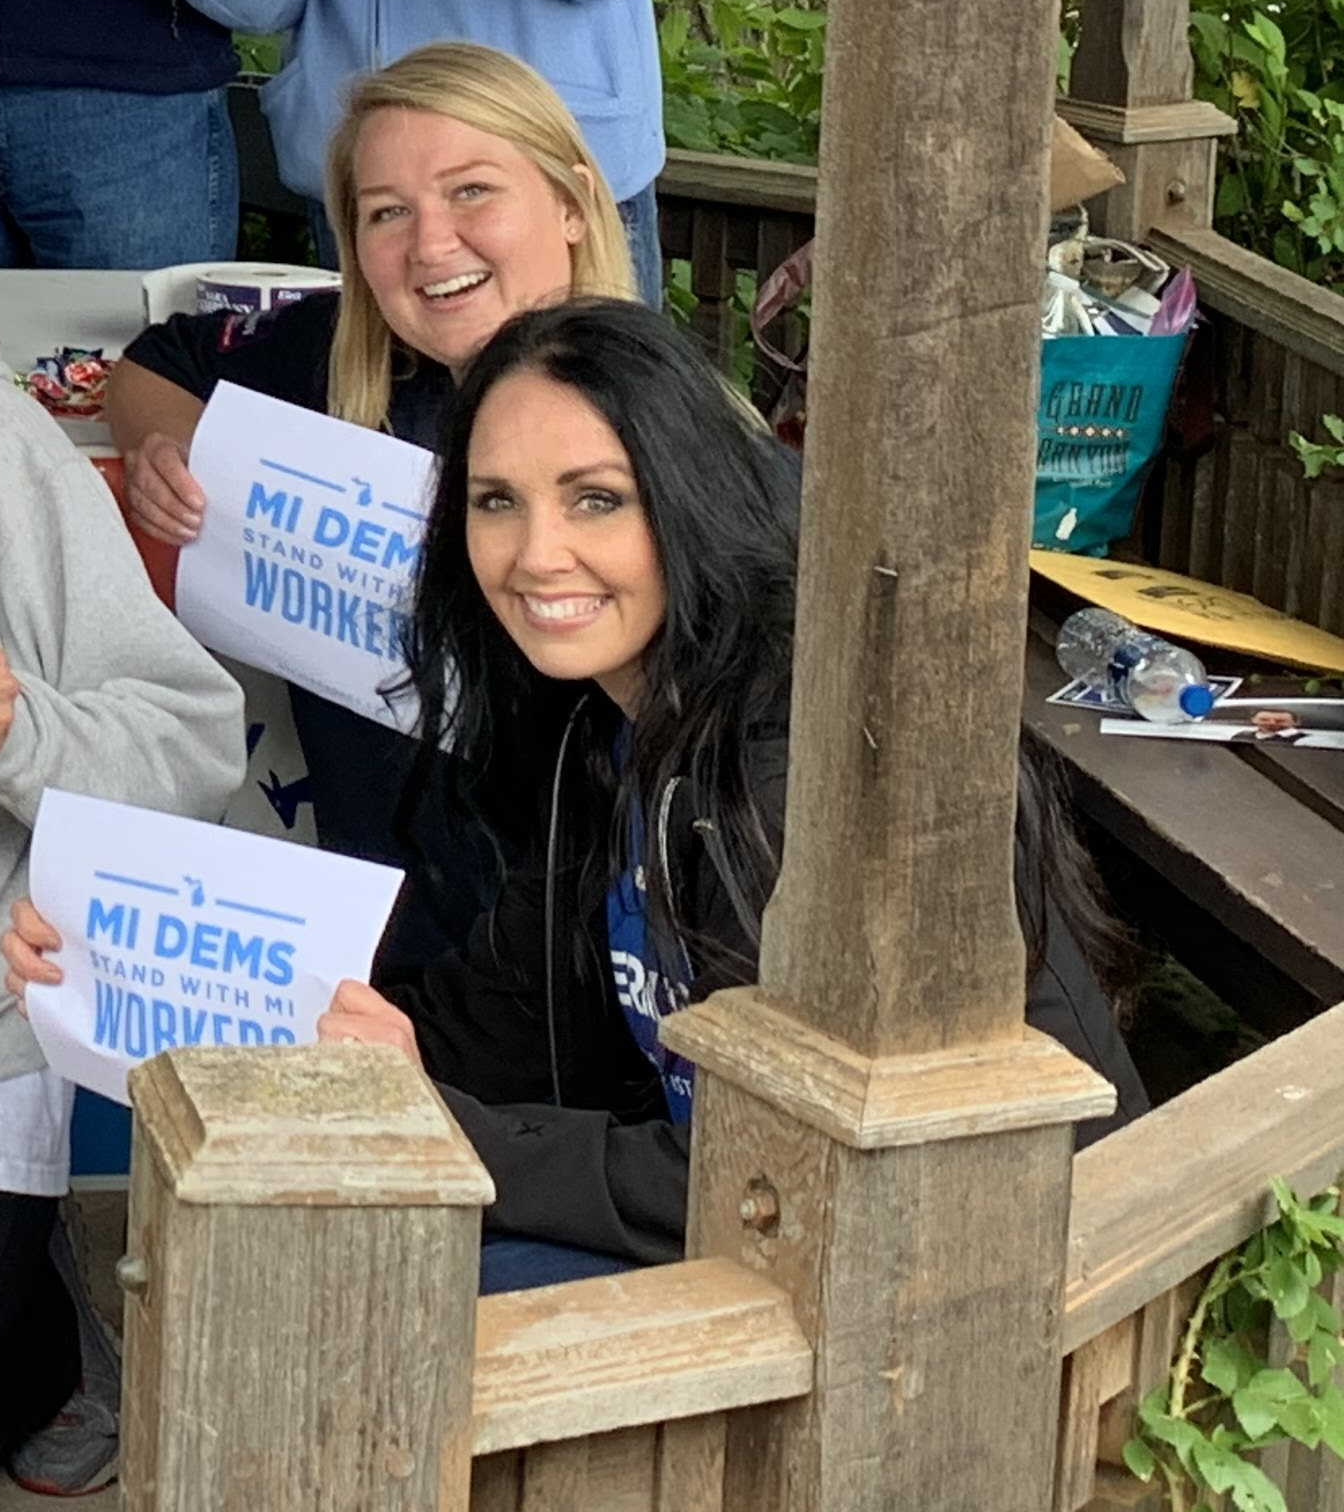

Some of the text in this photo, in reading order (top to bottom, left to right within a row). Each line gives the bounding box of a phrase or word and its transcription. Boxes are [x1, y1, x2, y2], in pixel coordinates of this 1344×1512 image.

[1045, 380, 1143, 424] GRAND
[243, 530, 401, 599] STAND WITH
[245, 483, 419, 570] MI DEM
[245, 551, 412, 661] WORKER
[85, 898, 294, 987] MI DEMS
[89, 950, 295, 1018] STAND WITH MI
